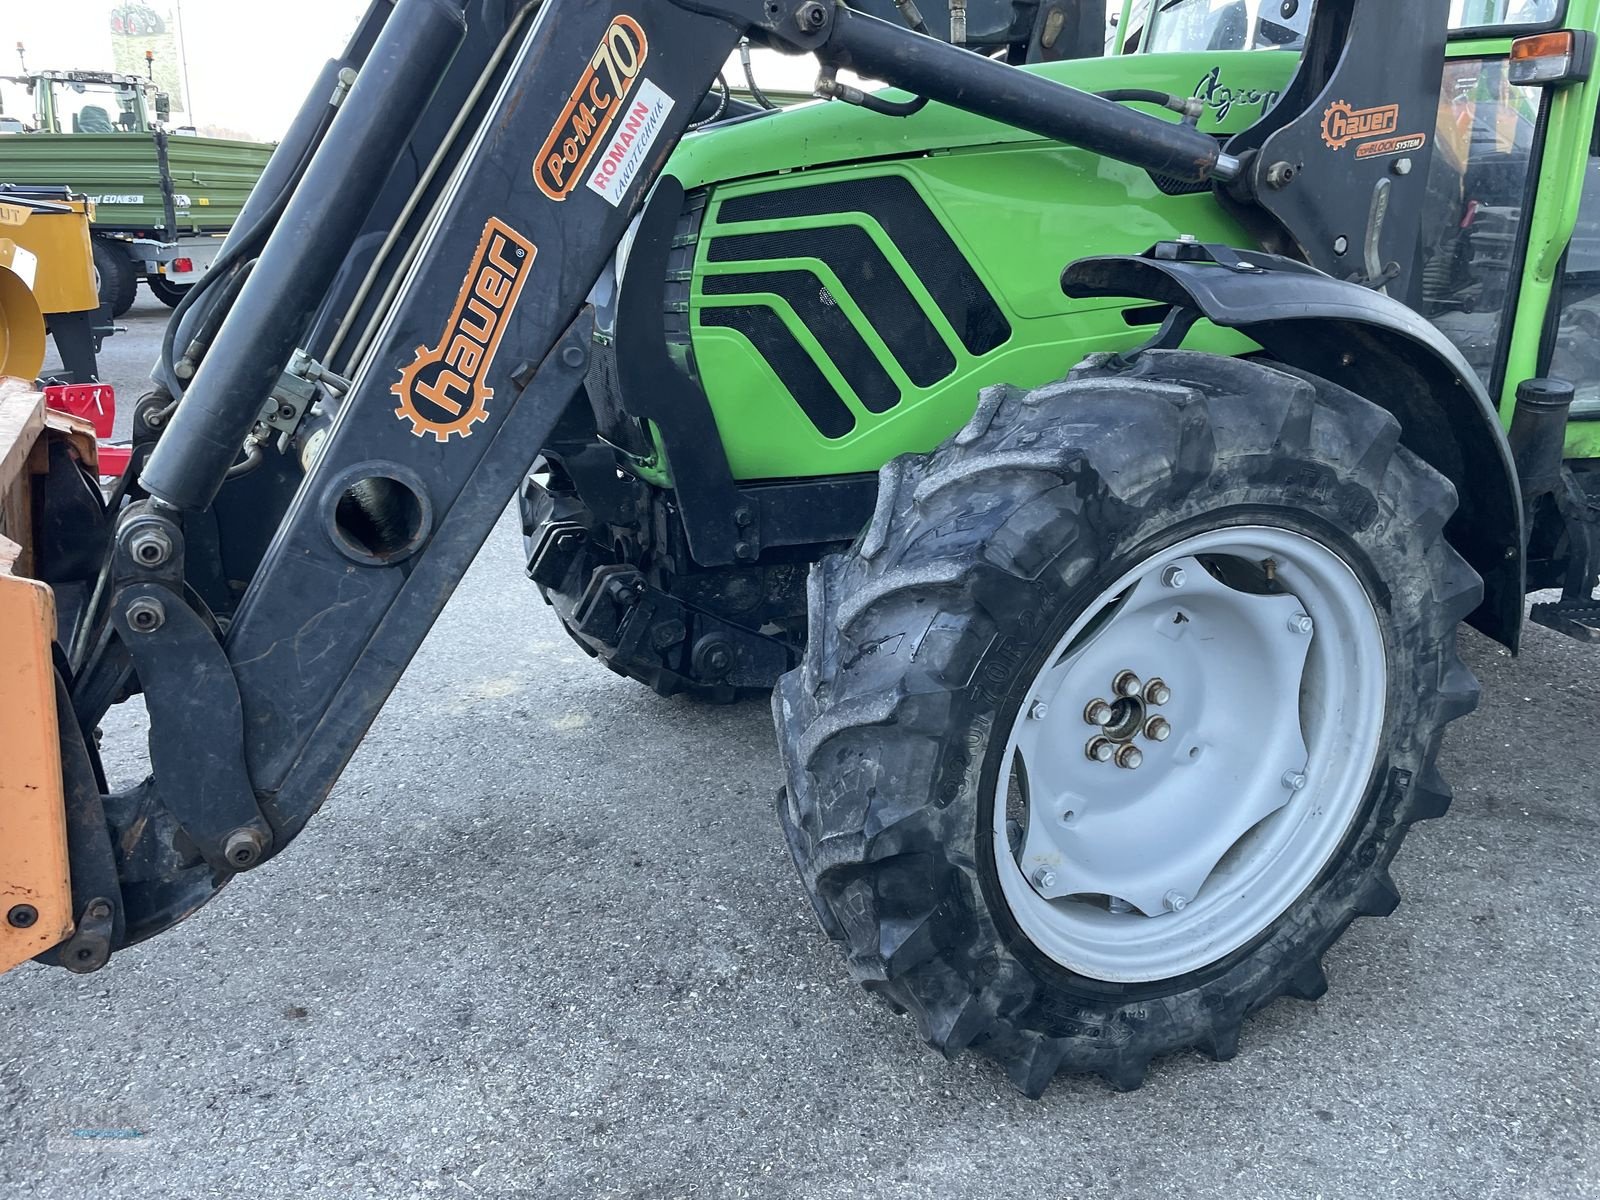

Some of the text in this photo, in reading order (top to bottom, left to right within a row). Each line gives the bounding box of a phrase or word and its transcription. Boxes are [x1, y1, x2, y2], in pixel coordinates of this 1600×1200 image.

[592, 23, 638, 100] 70
[594, 101, 649, 190] ROMANN
[614, 98, 664, 200] LANDTECHNIK
[1331, 110, 1394, 138] hauer
[1394, 138, 1420, 151] SYSTEM
[415, 234, 518, 416] hauer
